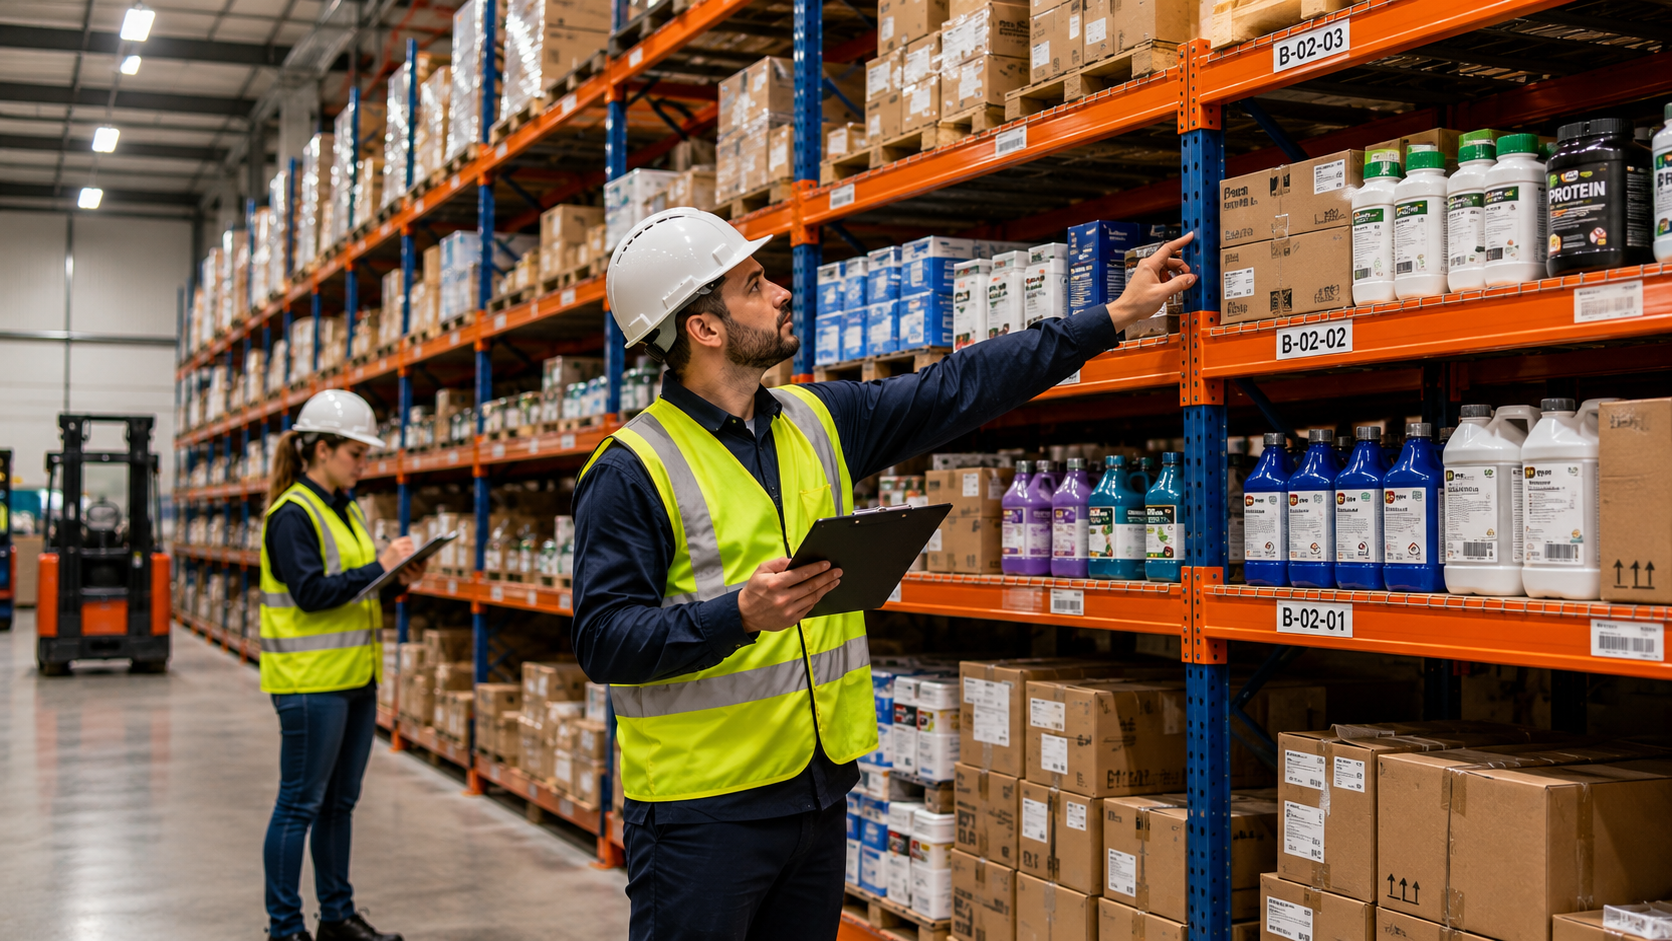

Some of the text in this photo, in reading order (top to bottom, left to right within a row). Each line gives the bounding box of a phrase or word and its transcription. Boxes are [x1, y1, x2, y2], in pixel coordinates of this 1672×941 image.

[1279, 27, 1343, 66] B-02-03
[1548, 180, 1606, 204] PROTEIN
[1282, 327, 1346, 354] B-02-02
[1283, 607, 1344, 631] B-02-01
